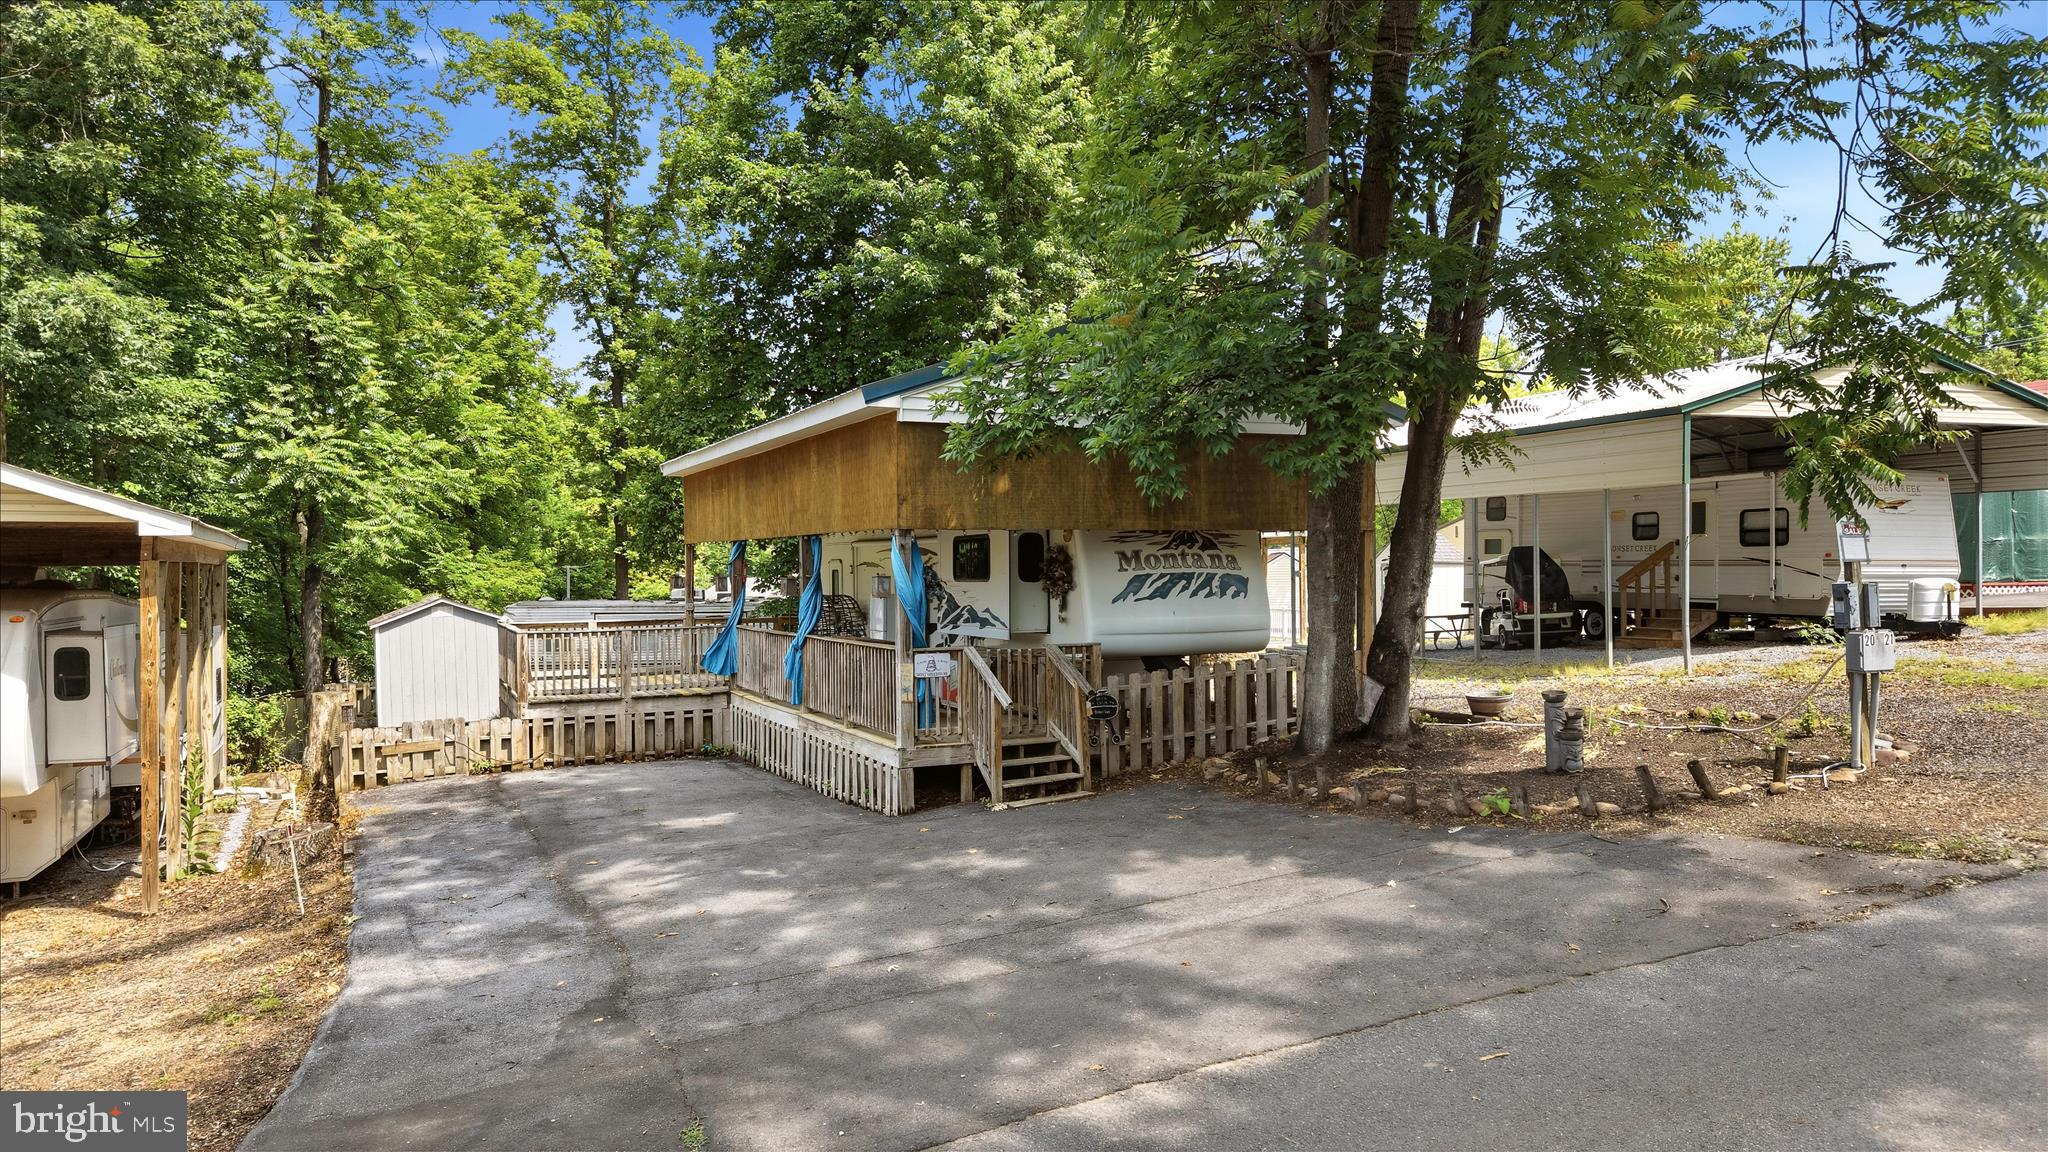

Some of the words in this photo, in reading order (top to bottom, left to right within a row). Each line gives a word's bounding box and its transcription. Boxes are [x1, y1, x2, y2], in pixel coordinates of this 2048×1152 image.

[1114, 549, 1242, 572] Montana
[1864, 634, 1875, 646] 20
[1884, 633, 1894, 645] 21
